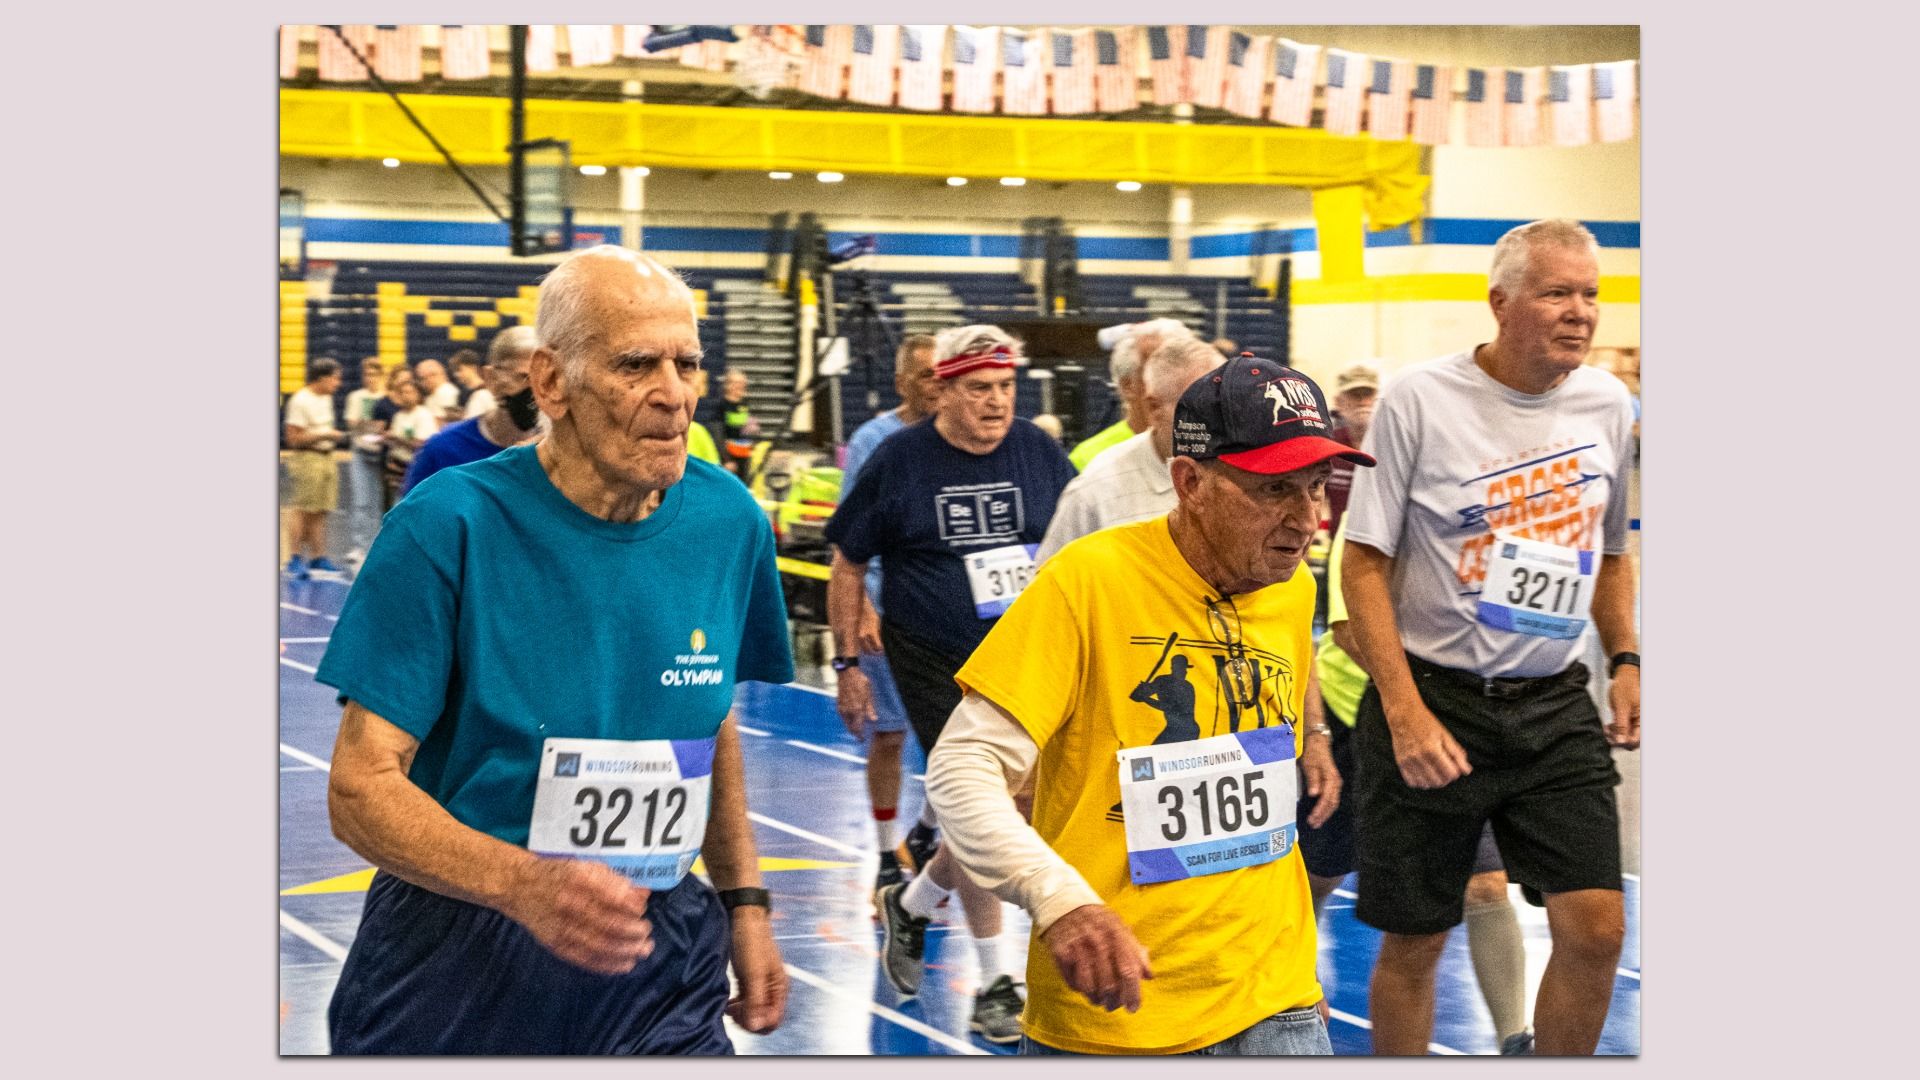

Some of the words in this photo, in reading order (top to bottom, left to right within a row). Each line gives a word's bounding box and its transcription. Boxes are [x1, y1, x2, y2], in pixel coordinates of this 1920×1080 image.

[1507, 566, 1581, 615] 3211
[569, 786, 688, 848] 3212
[1157, 770, 1269, 842] 3165
[1186, 855, 1207, 867] SCAN
[1208, 851, 1221, 863] FOR
[1223, 848, 1239, 860] LIVE
[1240, 842, 1269, 856] RESULTS
